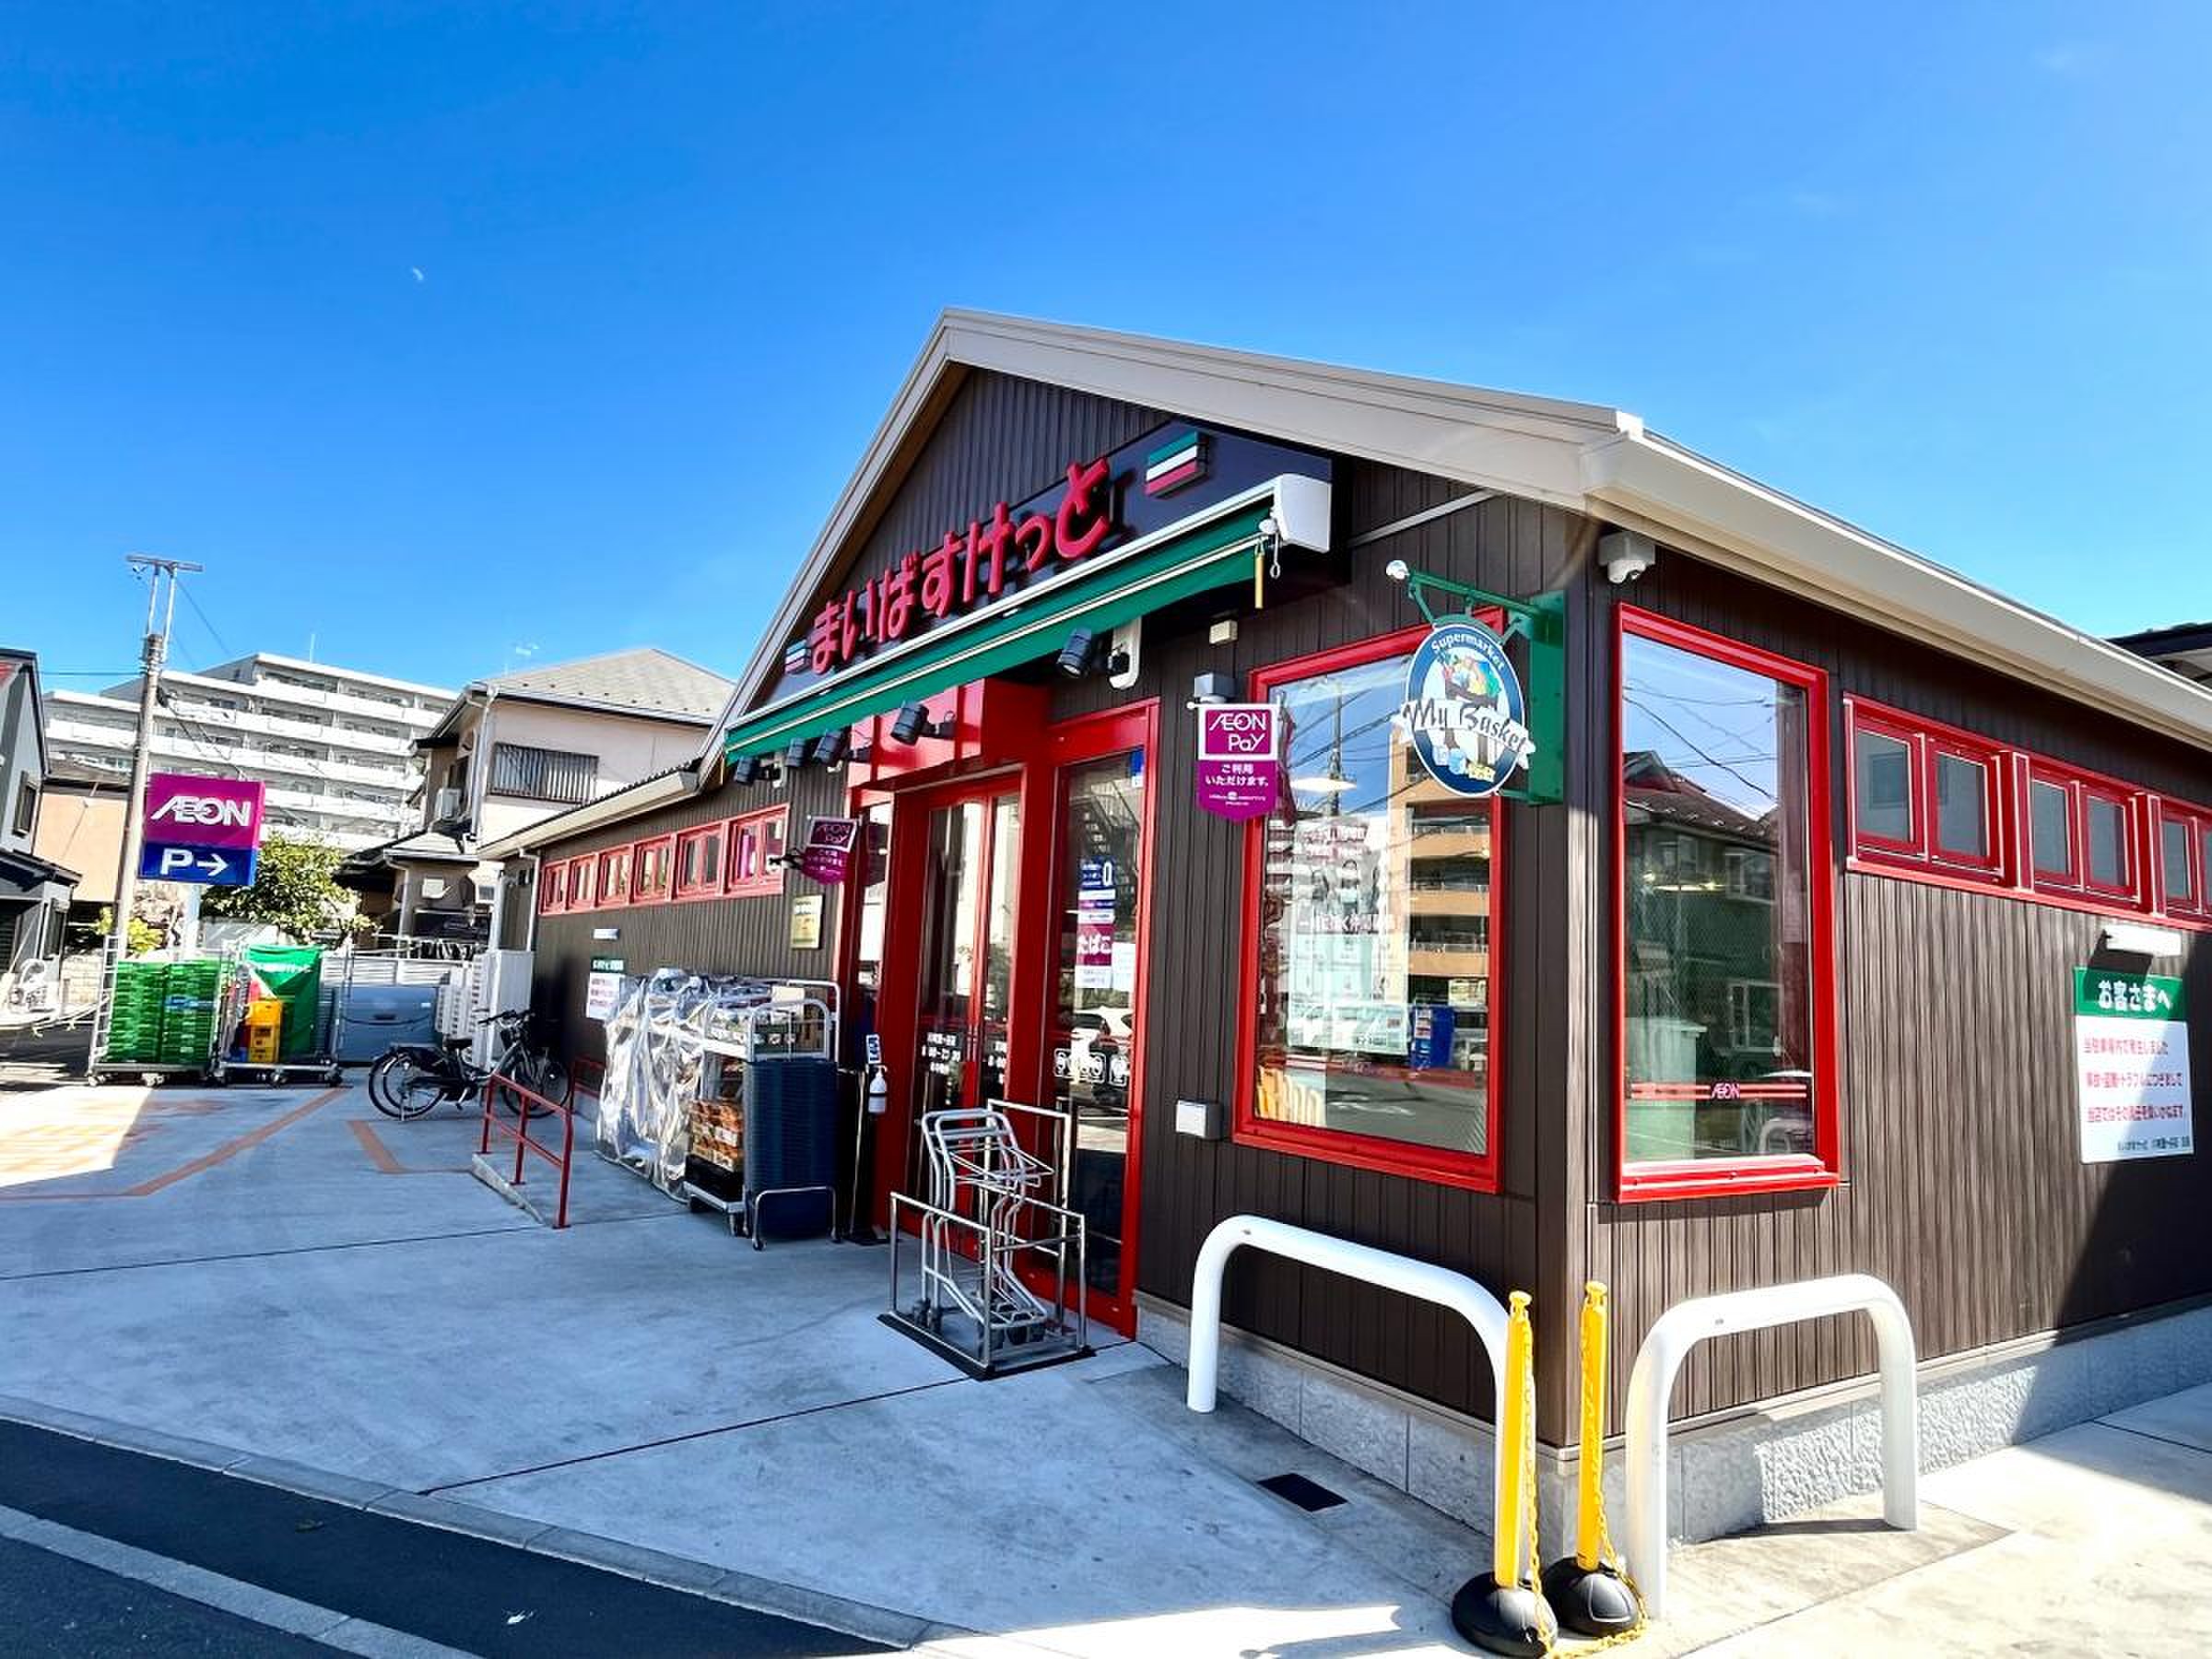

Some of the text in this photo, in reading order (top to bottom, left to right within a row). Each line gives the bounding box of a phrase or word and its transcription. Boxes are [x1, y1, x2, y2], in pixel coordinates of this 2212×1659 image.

[810, 457, 1112, 675] まいばすけっと
[1430, 632, 1506, 671] Supermarket
[1402, 698, 1448, 732] My
[159, 847, 194, 877] P
[1077, 933, 1112, 955] たばこ
[2097, 980, 2172, 1012] お客さまへ
